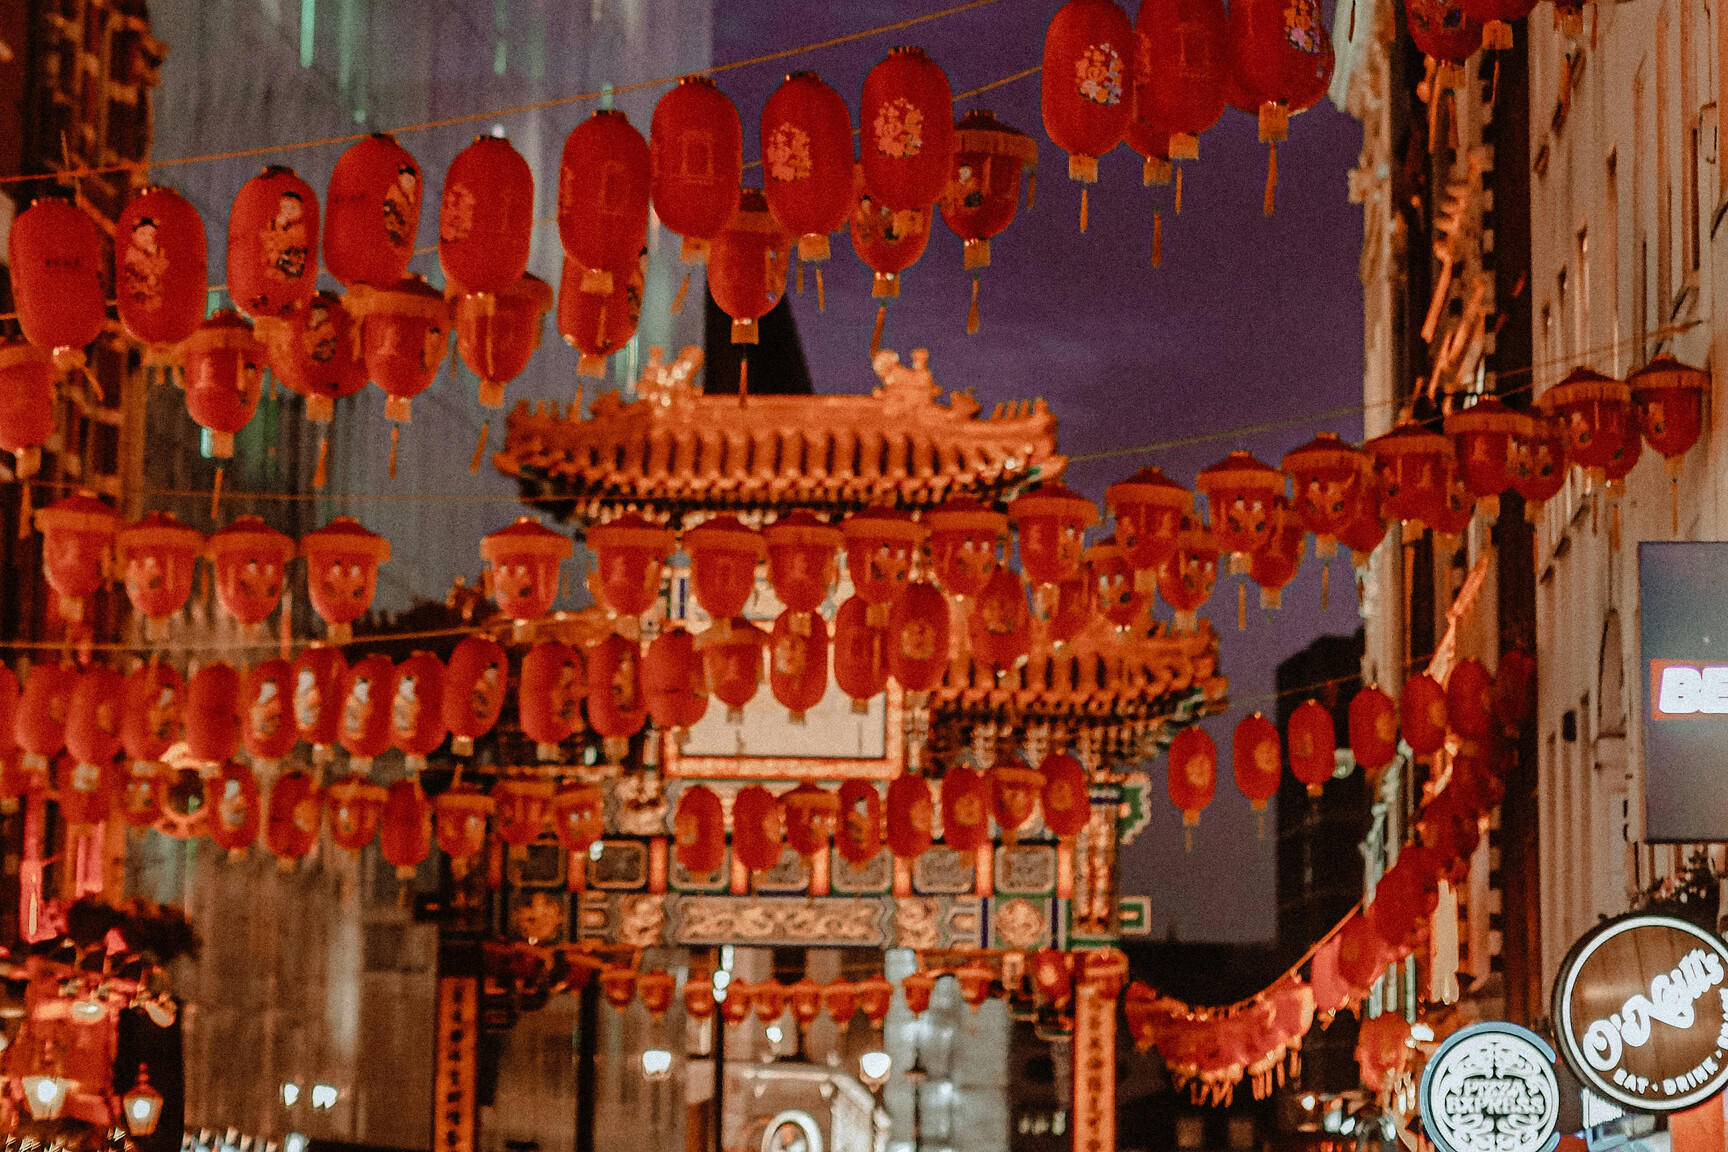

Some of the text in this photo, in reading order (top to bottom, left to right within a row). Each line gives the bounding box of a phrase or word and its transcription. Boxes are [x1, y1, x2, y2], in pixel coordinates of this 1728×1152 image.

[1612, 1055, 1719, 1096] EAT DRINK
[1464, 1078, 1526, 1099] PIZZA
[1445, 1094, 1546, 1115] EXPRESS
